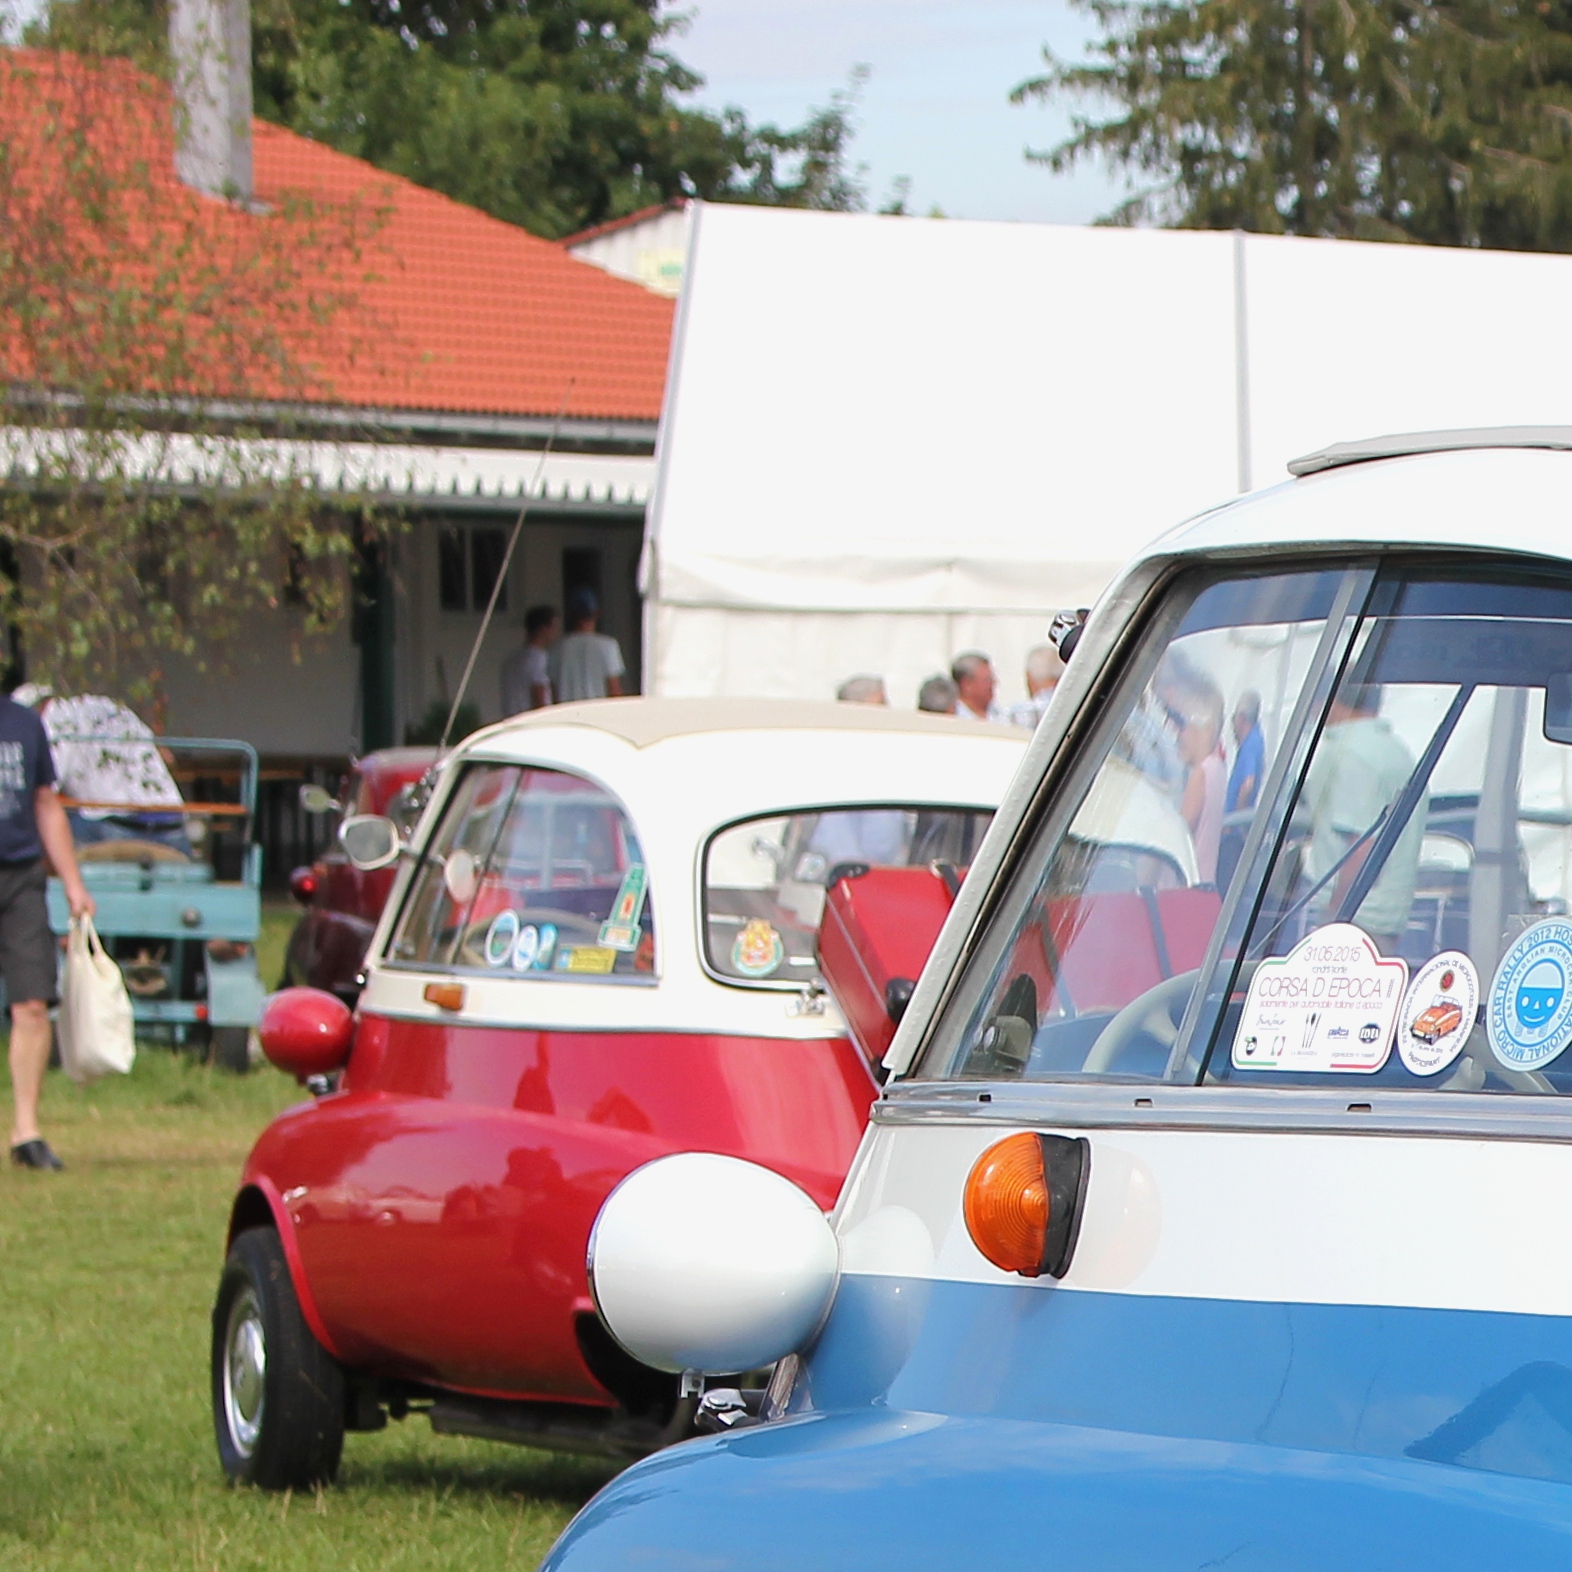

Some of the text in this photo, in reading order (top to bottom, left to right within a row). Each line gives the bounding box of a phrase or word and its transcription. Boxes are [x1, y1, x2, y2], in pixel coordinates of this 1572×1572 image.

[1526, 928, 1552, 949] 2012
[1497, 944, 1527, 991] RALLY
[1512, 946, 1546, 983] ANGLIAN
[1259, 977, 1308, 998] CORSA
[1328, 977, 1381, 998] EPOCA
[1493, 996, 1503, 1027] CAR
[1497, 1030, 1524, 1060] MICRO
